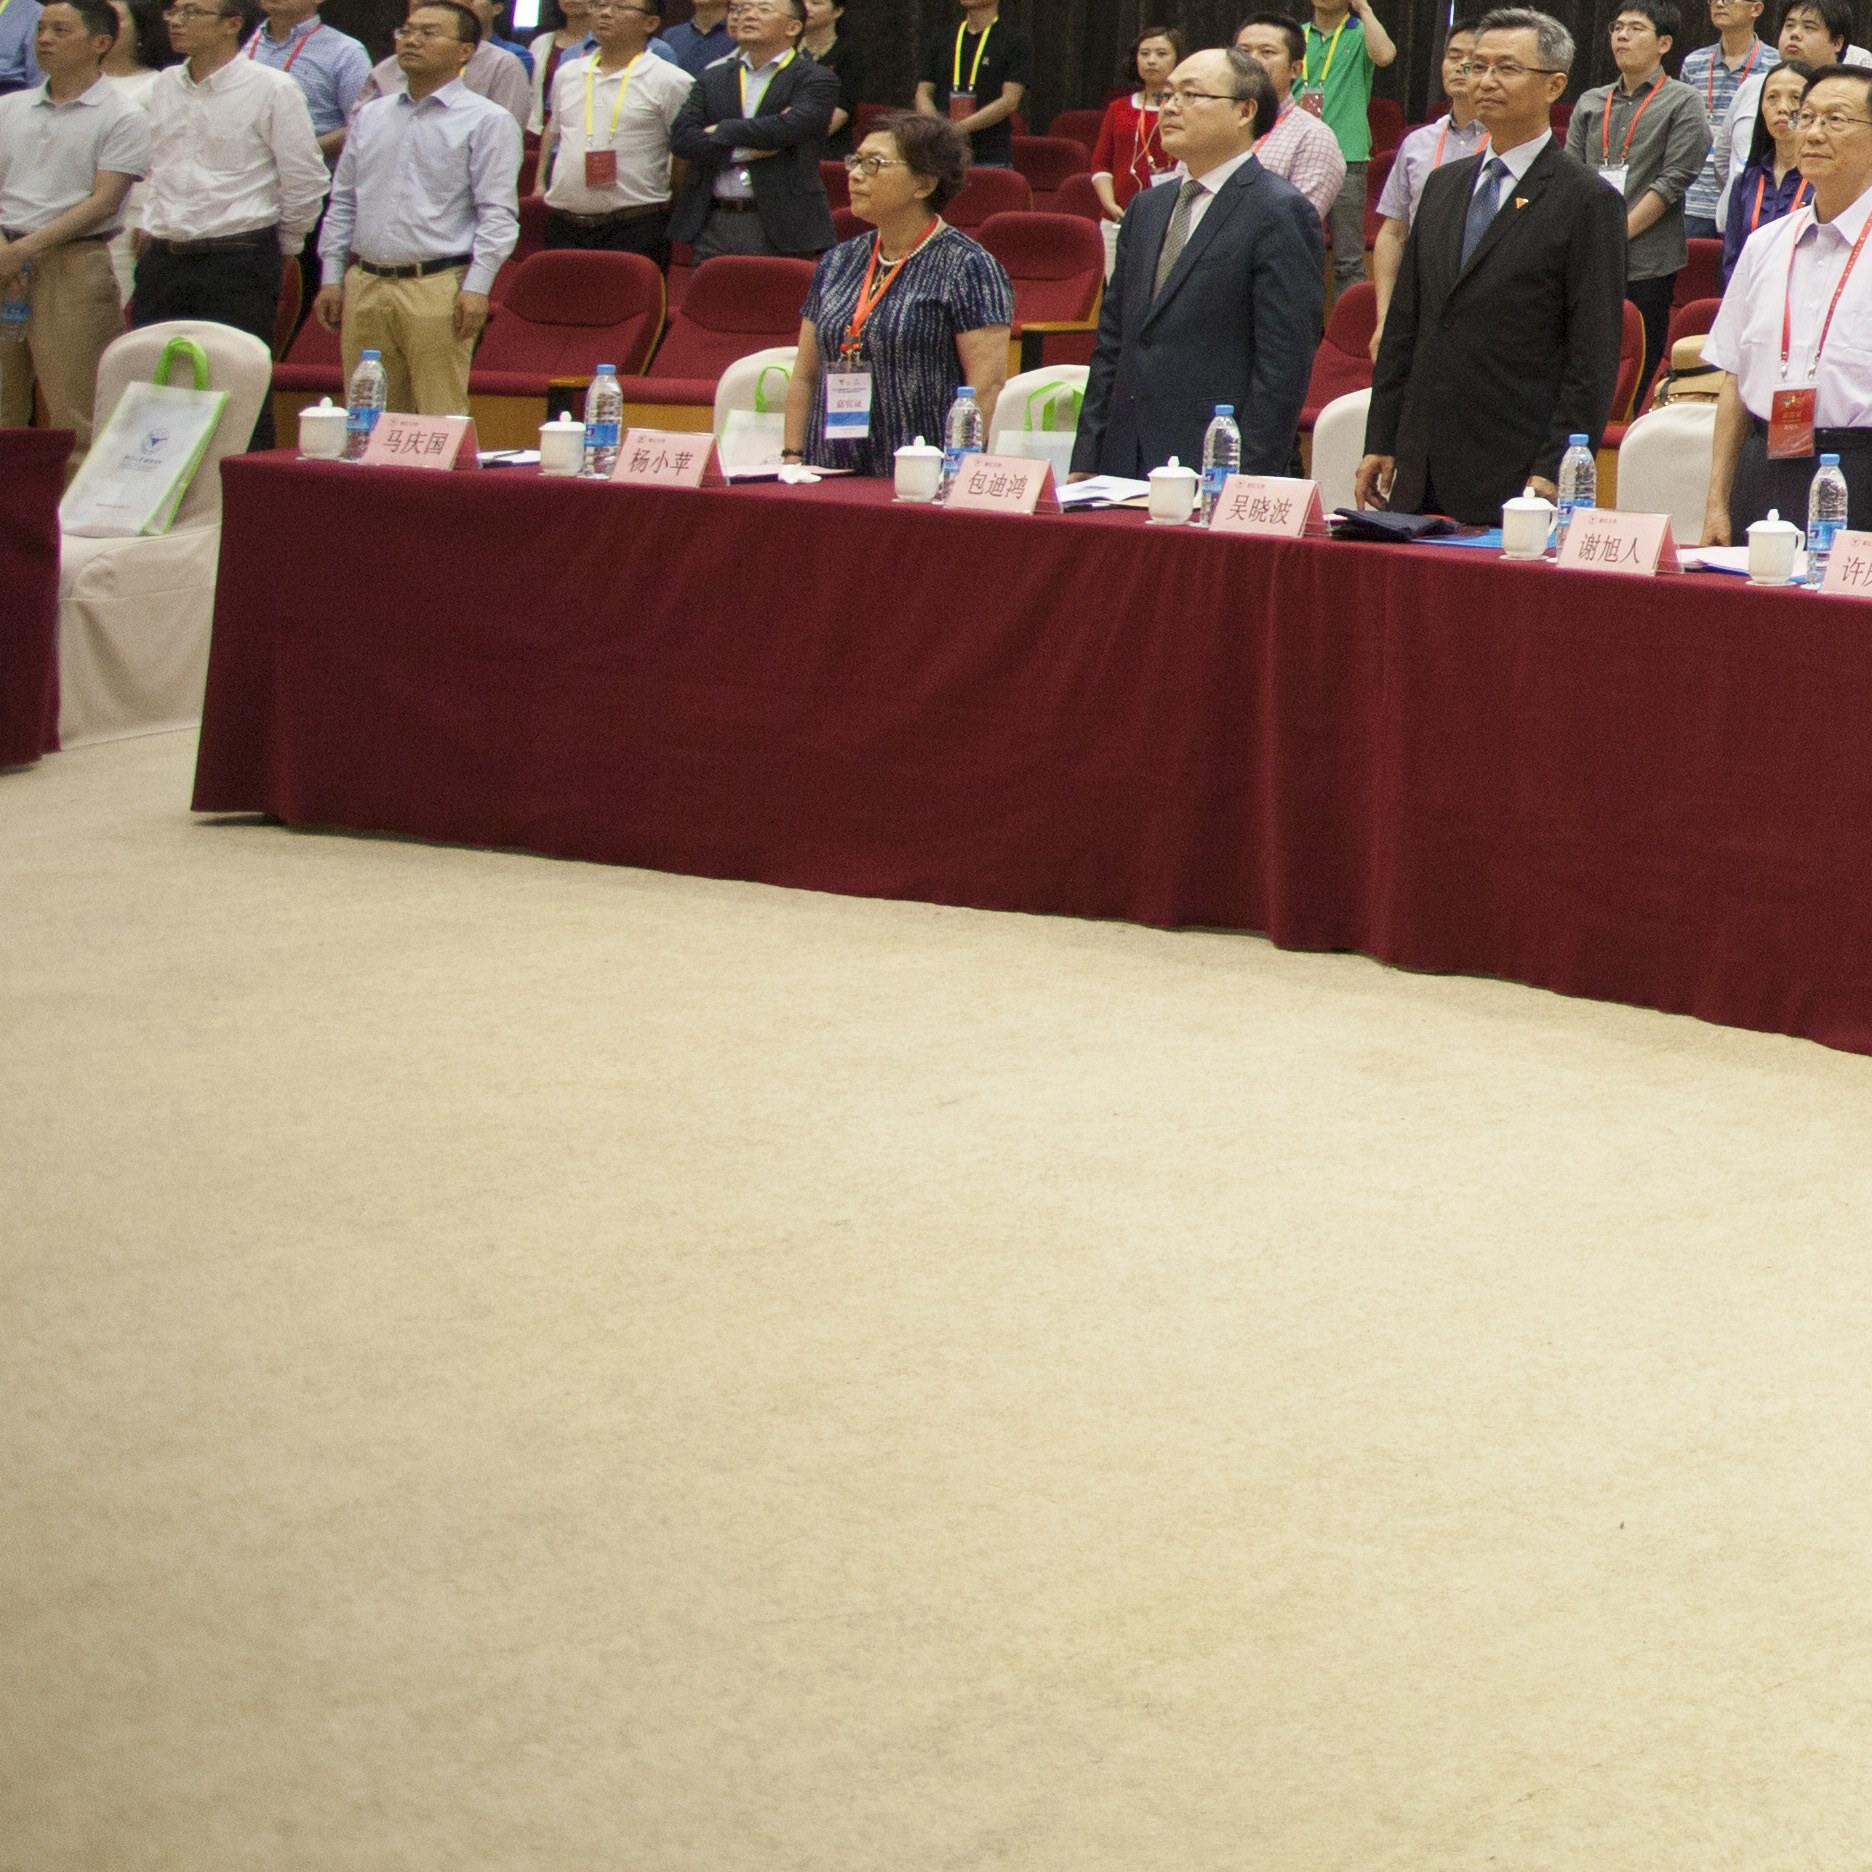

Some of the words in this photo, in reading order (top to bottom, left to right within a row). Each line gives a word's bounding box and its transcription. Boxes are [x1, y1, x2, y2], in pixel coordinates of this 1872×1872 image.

[383, 429, 449, 456] 马庆国
[629, 448, 694, 476] 杨小苹
[968, 470, 1029, 500] 包迪鸿
[1225, 494, 1293, 525] 吴晓波
[1577, 533, 1641, 565] 谢旭人
